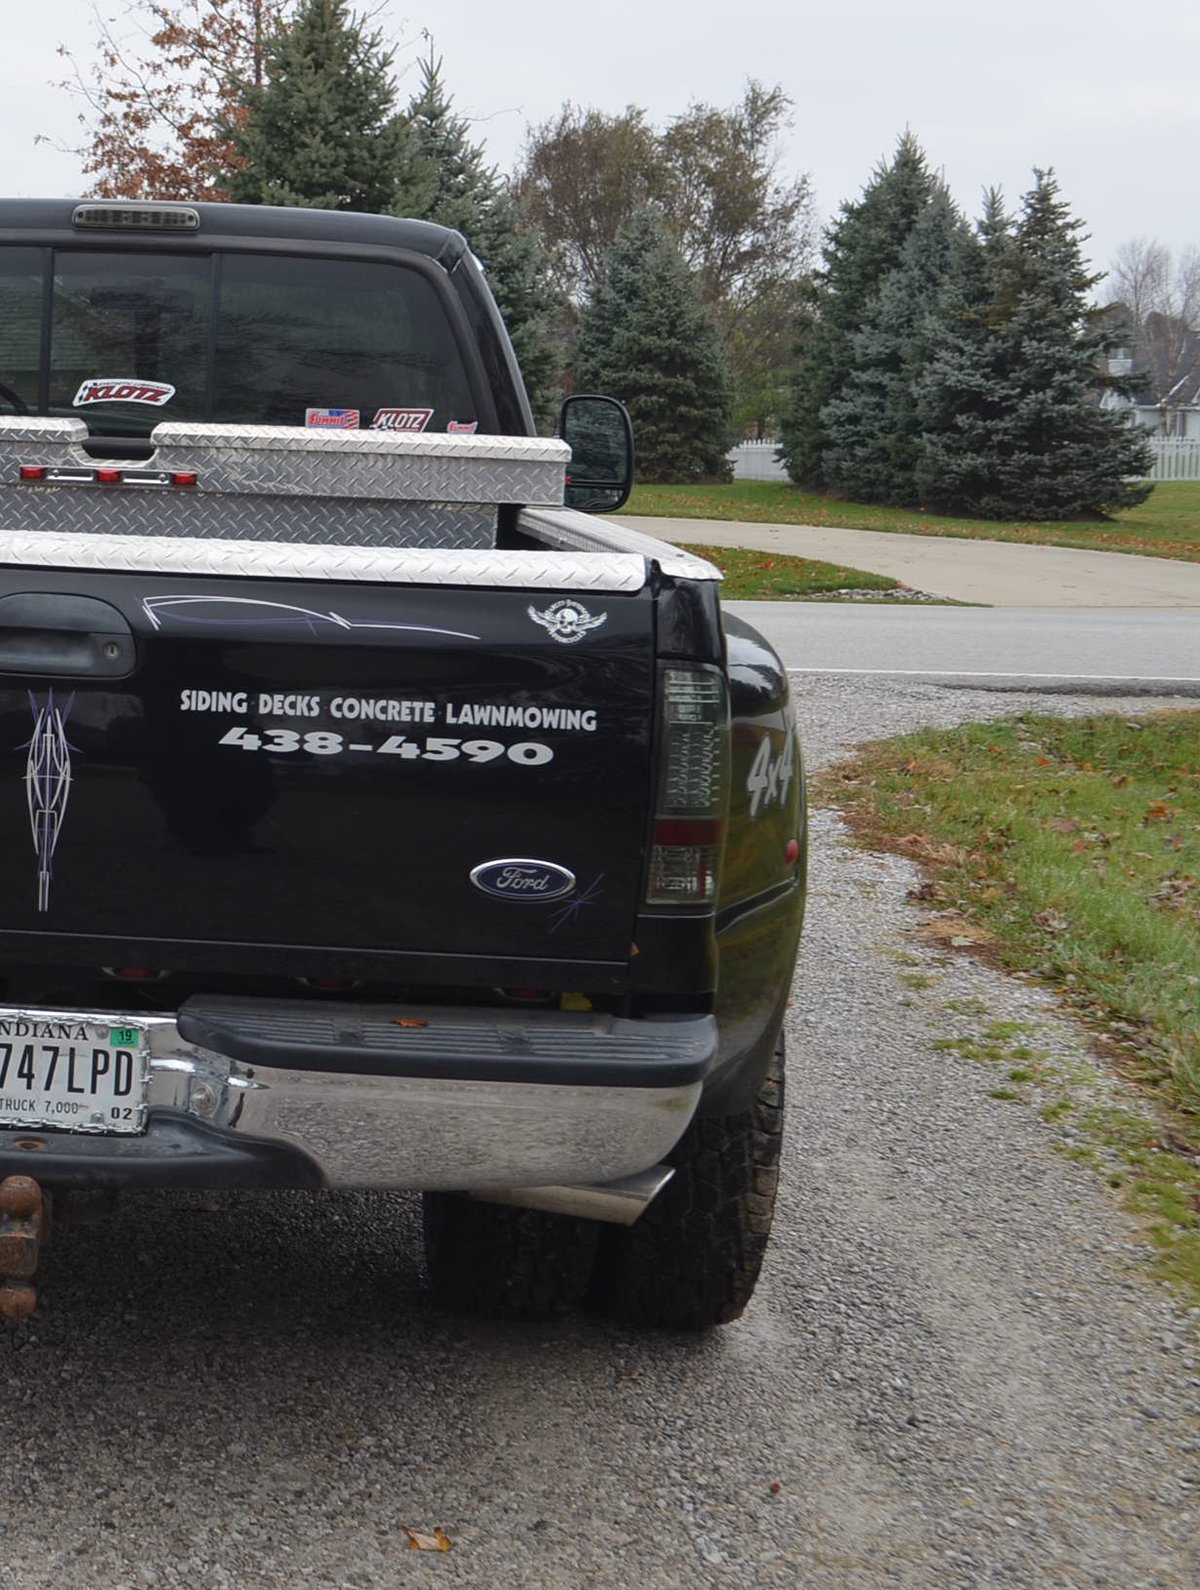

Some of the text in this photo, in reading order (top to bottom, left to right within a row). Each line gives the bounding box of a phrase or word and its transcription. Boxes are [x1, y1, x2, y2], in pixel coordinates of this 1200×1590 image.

[83, 385, 171, 403] KLOTZ
[377, 412, 426, 429] KLOTZ
[180, 689, 598, 732] SIDING DECKS CONCRETE LAWNMOWING
[218, 726, 555, 766] 438-4590
[495, 866, 550, 891] Ford
[118, 1029, 133, 1042] 19
[44, 1099, 80, 1115] 7,000
[111, 1106, 133, 1120] 02
